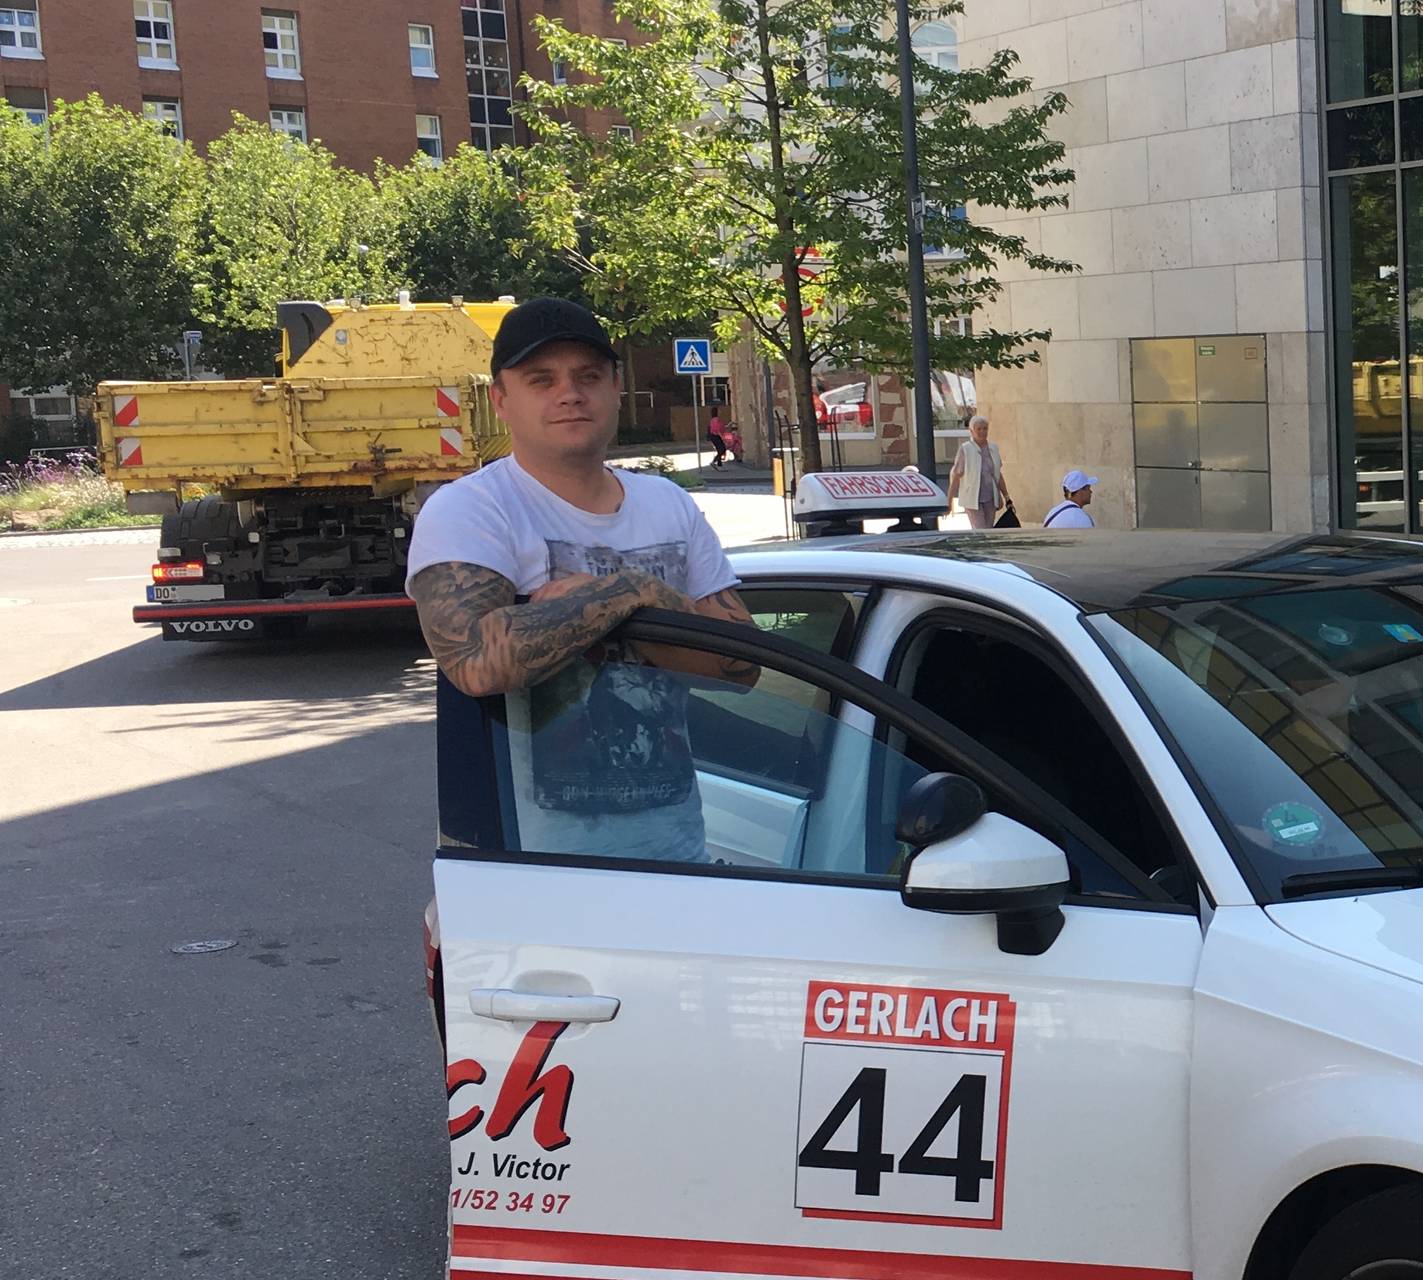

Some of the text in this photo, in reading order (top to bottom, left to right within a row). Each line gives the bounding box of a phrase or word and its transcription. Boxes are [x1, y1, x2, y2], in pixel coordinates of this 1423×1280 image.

[822, 475, 928, 495] FAHRSCHULE
[155, 588, 170, 599] DO
[170, 620, 254, 633] VOLVO
[814, 989, 999, 1043] GERLACH
[799, 1067, 995, 1203] 44
[457, 1152, 571, 1181] J. Victor
[451, 1188, 571, 1214] 1/52 34 97
